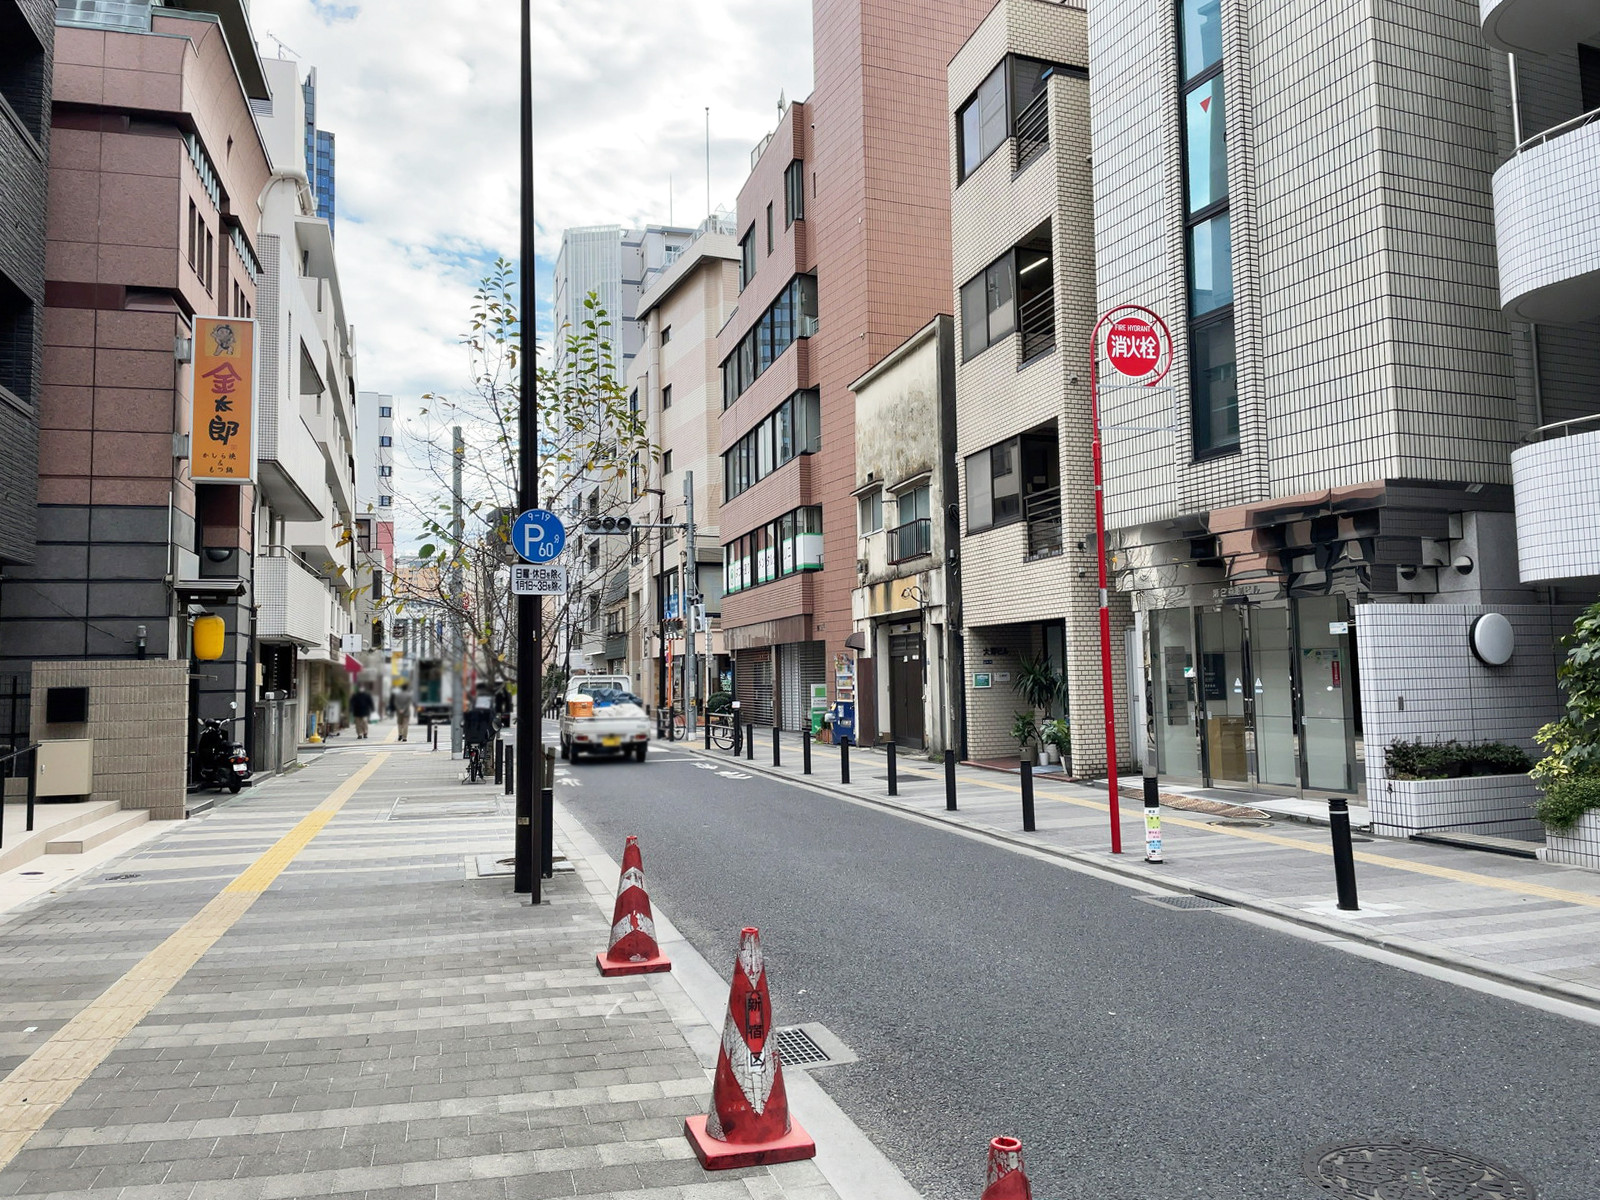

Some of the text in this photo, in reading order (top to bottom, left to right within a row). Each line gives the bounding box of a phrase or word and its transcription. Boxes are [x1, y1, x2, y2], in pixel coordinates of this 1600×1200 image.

[1111, 335, 1157, 359] 消火栓
[202, 361, 242, 446] 金太郎
[528, 512, 550, 521] 9-19
[524, 524, 545, 556] P
[747, 998, 764, 1066] 新宿区
